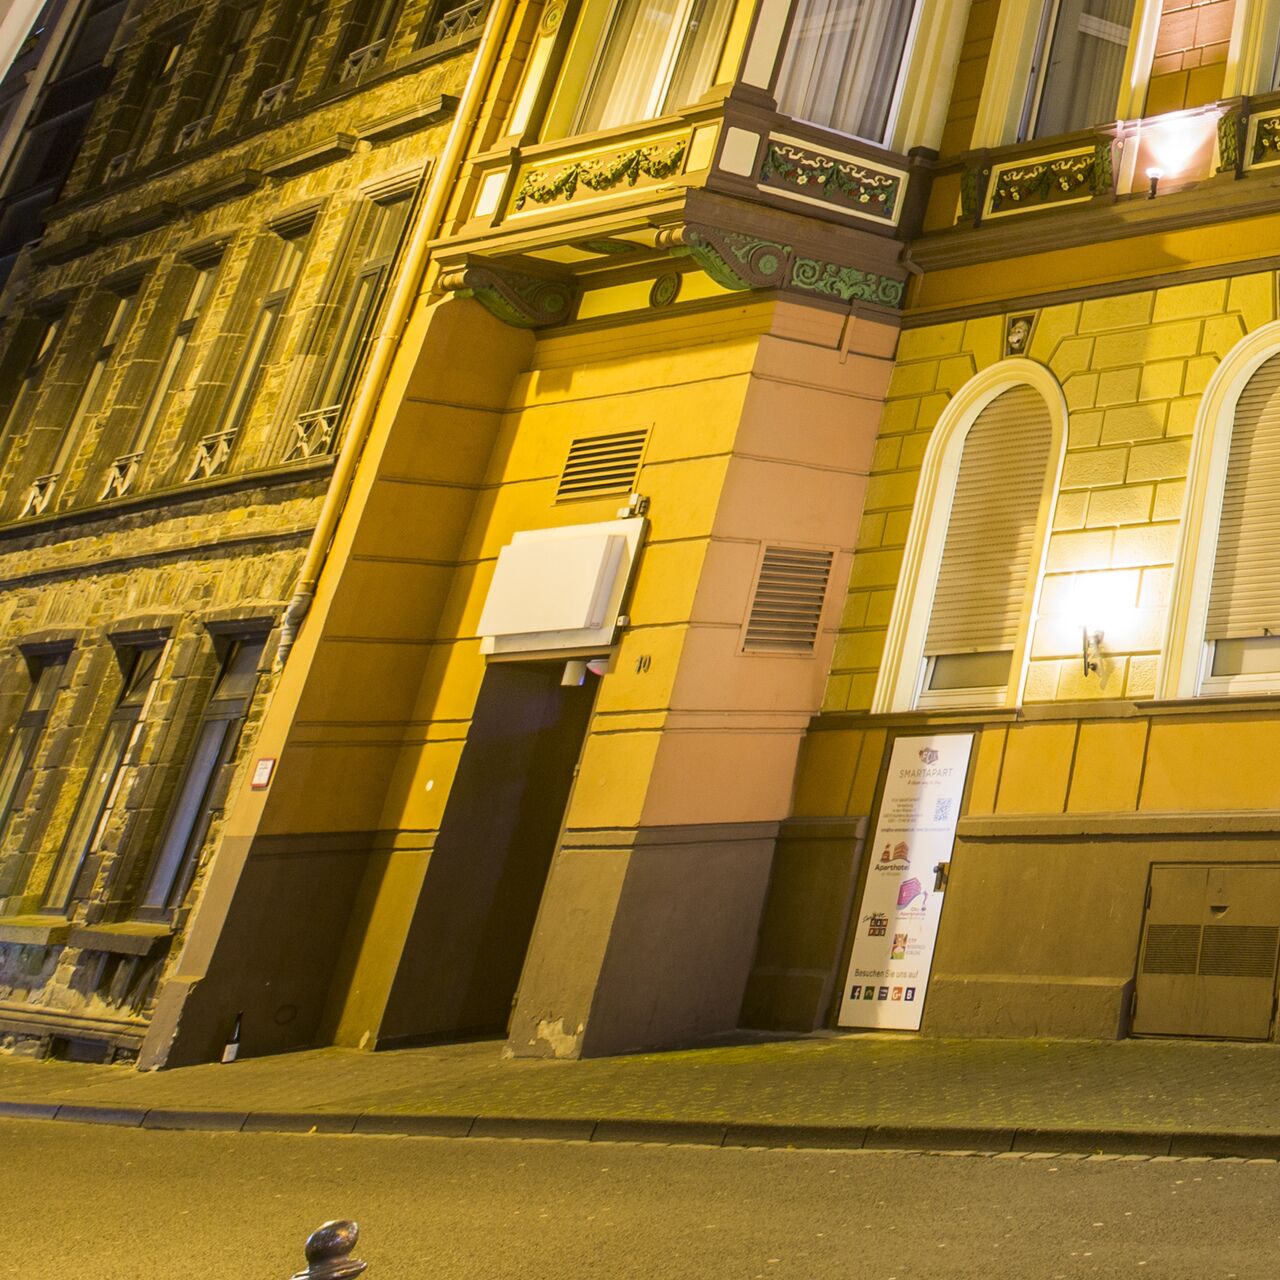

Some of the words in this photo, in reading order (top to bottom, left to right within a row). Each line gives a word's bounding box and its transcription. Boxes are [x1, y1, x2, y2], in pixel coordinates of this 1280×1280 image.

[635, 655, 651, 674] 10
[899, 768, 954, 778] SMARTAPART
[874, 863, 910, 872] Aparthotel
[854, 968, 884, 978] Besuchen
